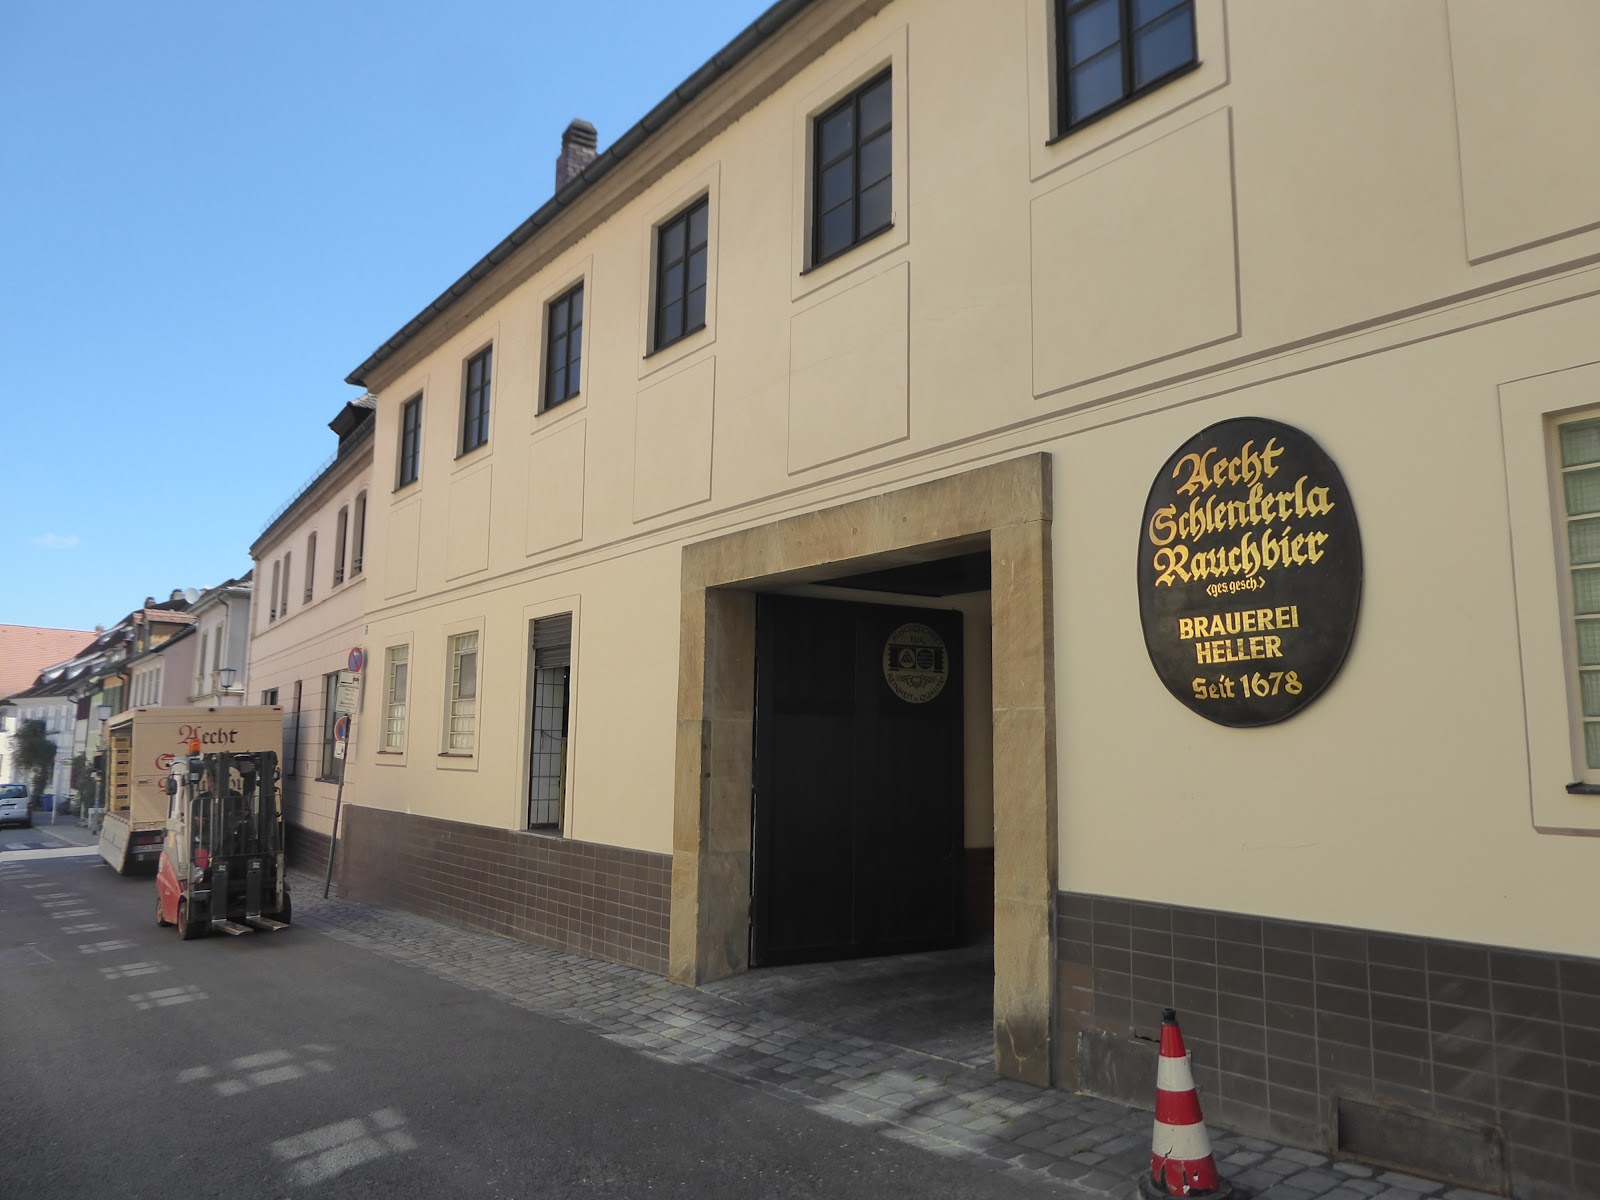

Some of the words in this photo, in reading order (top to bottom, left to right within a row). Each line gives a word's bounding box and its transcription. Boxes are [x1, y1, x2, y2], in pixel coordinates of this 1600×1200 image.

[1172, 437, 1284, 496] Aecht
[1148, 475, 1335, 546] Schlenkerla
[1153, 526, 1329, 587] Rauchbier
[1178, 605, 1300, 640] BRAUEREI
[1195, 635, 1283, 665] HELLER
[1192, 674, 1235, 700] Seit
[1239, 670, 1303, 698] 1678
